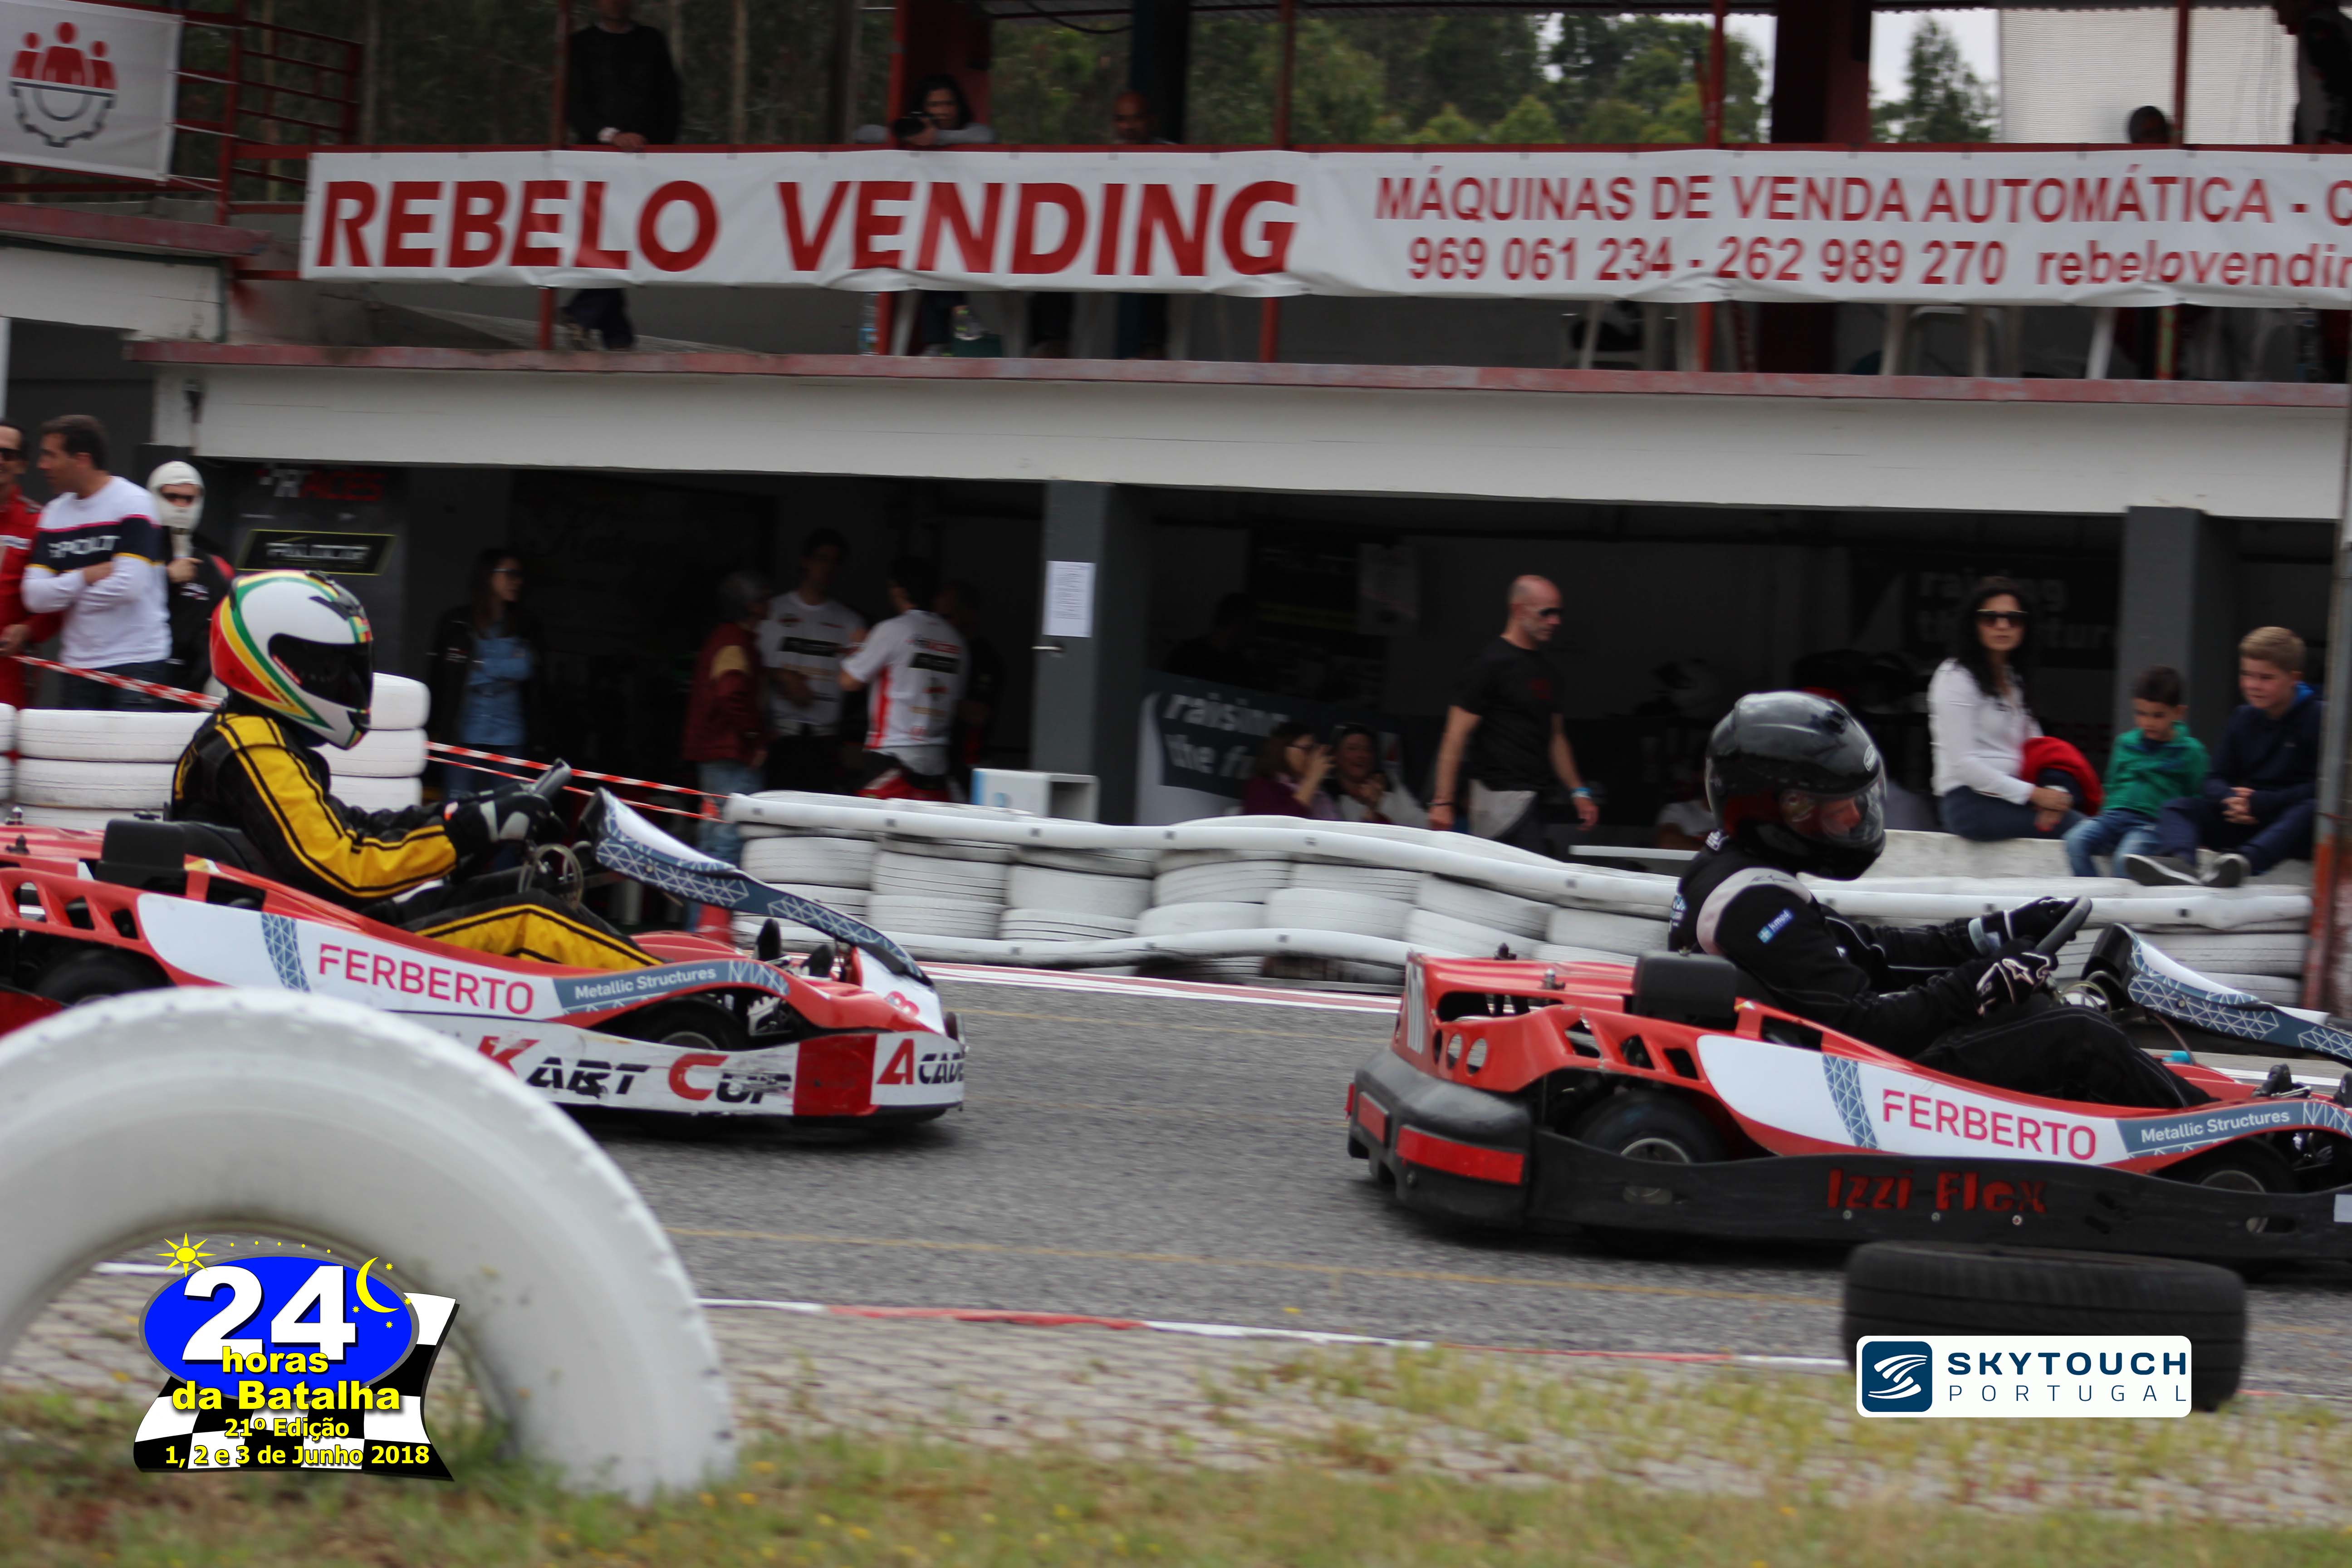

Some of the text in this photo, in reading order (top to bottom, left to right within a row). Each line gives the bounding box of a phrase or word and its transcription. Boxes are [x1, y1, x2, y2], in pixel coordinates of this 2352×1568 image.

[1377, 167, 1635, 221] MÁQUINAS
[1652, 175, 1712, 220] DE
[1733, 176, 1909, 222] VENDA
[1923, 165, 2273, 224] AUTOMÁTICA
[316, 180, 1297, 276] REBELO VENDING
[1410, 237, 1487, 280] 969
[1504, 237, 1576, 281] 061
[1596, 237, 1675, 281] 234
[1715, 236, 1805, 282] 262
[1821, 239, 1905, 284] 989
[1921, 240, 2007, 285] 270
[319, 943, 534, 1014] FERBERTO
[574, 968, 717, 1000] Metallic Structures
[1882, 1088, 2097, 1161] FERBERTO
[2141, 1111, 2290, 1143] Metallic Structures
